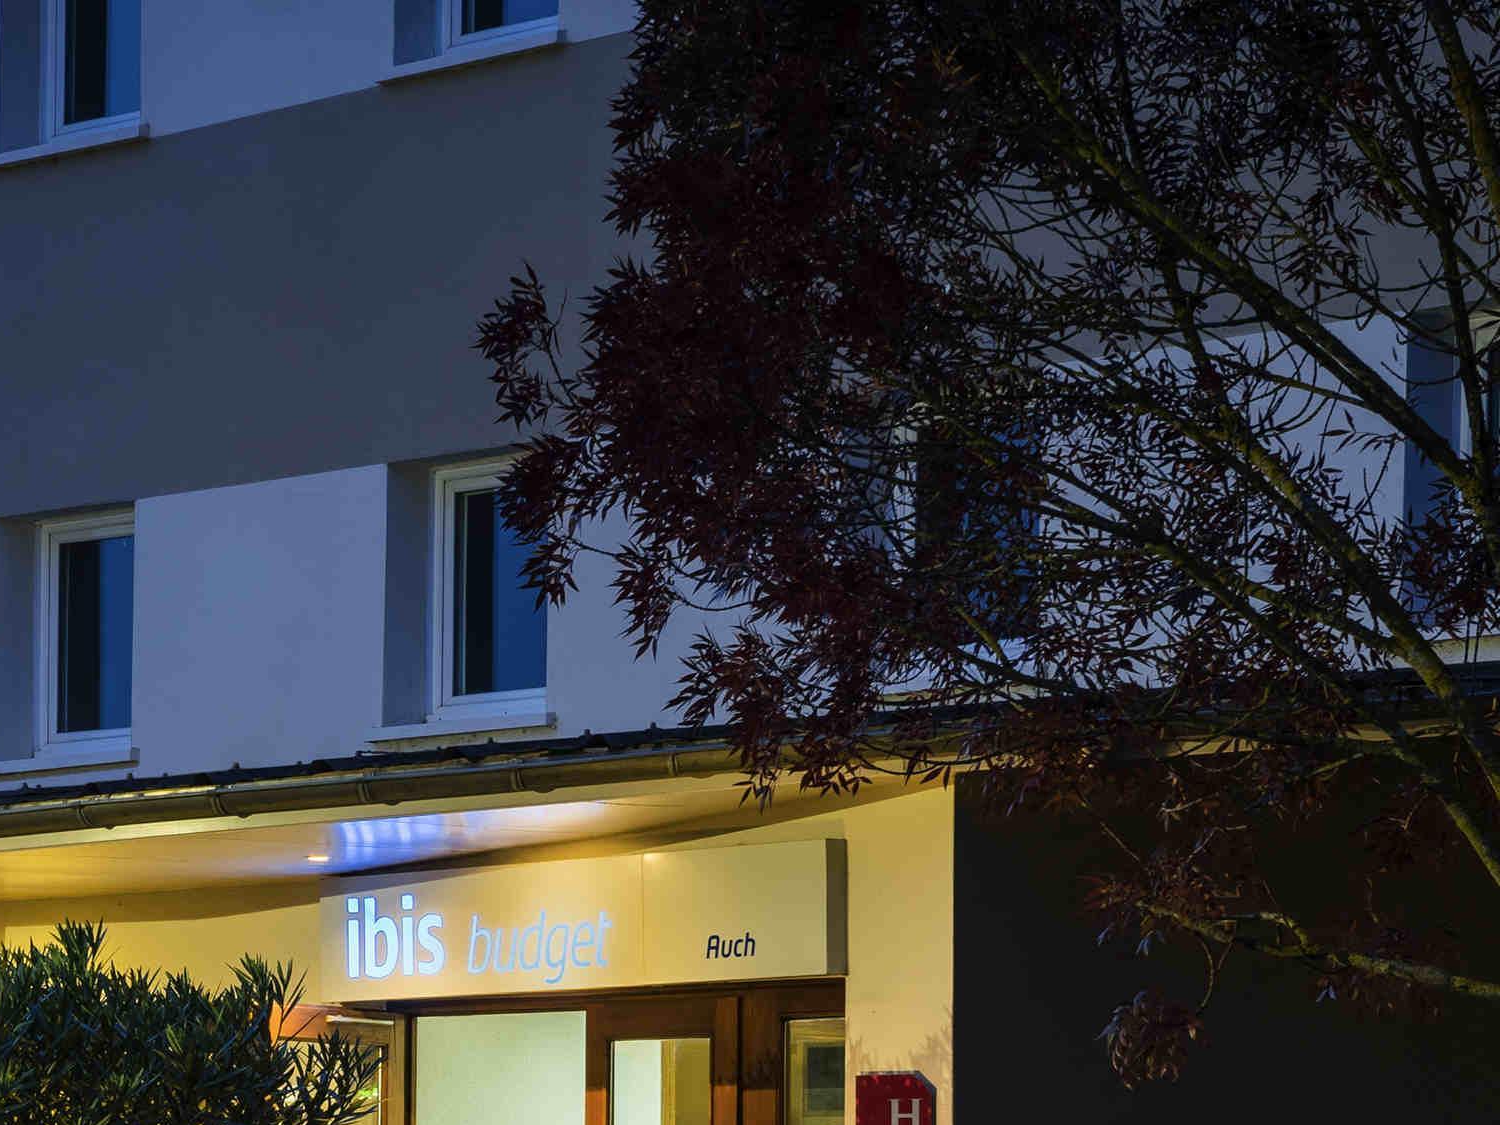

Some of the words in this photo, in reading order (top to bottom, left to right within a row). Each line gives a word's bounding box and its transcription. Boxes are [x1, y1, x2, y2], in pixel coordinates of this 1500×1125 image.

[347, 893, 446, 979] ibis
[467, 911, 612, 984] budget
[706, 931, 756, 959] Auch
